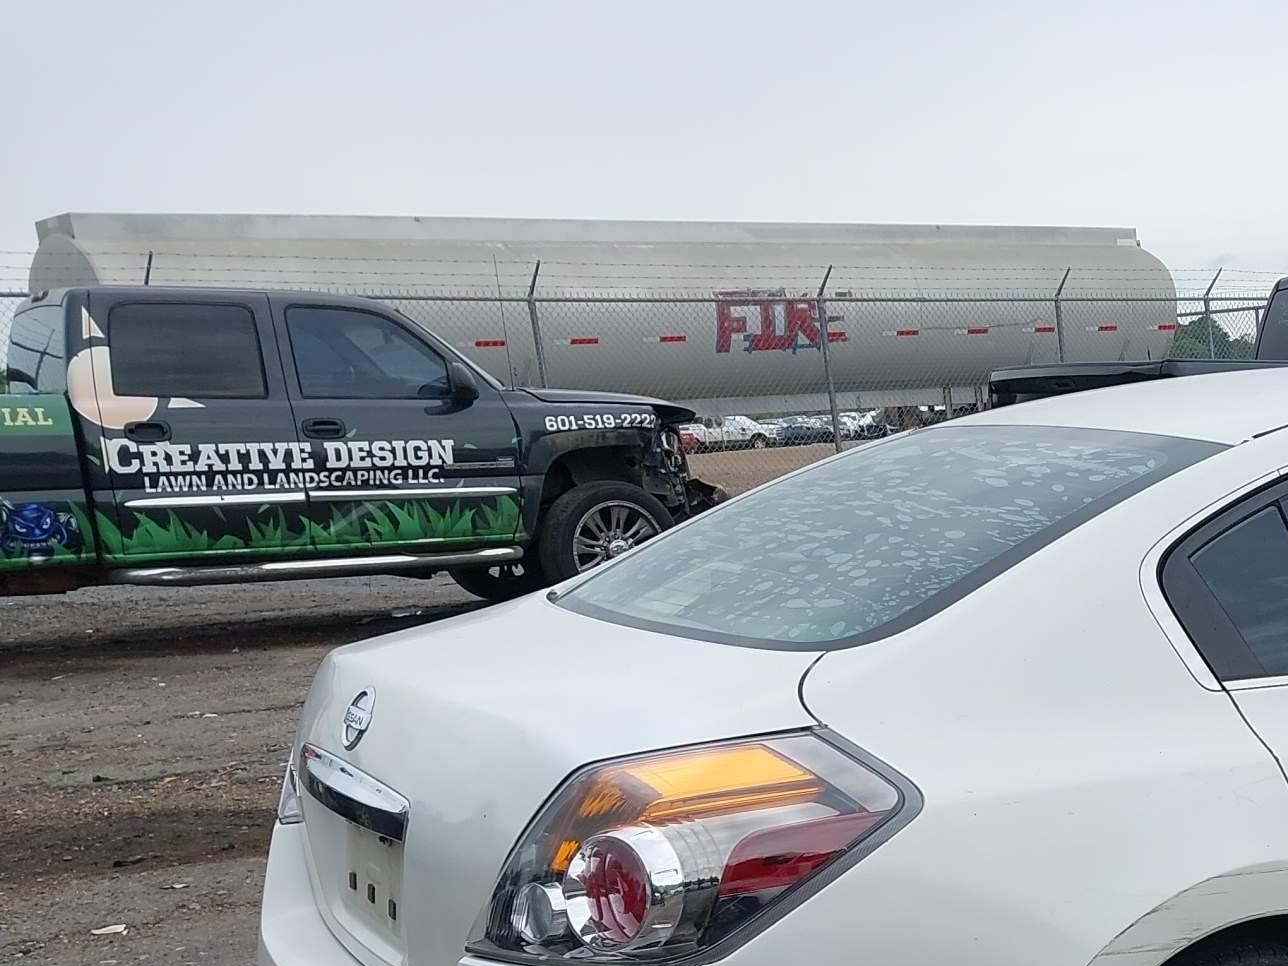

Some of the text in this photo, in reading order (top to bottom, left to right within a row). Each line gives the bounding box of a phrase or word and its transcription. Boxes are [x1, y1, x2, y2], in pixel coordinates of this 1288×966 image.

[104, 438, 454, 474] CREATIVE DESIGN
[144, 468, 445, 492] LAWN AND LANDSCAPING LLC.
